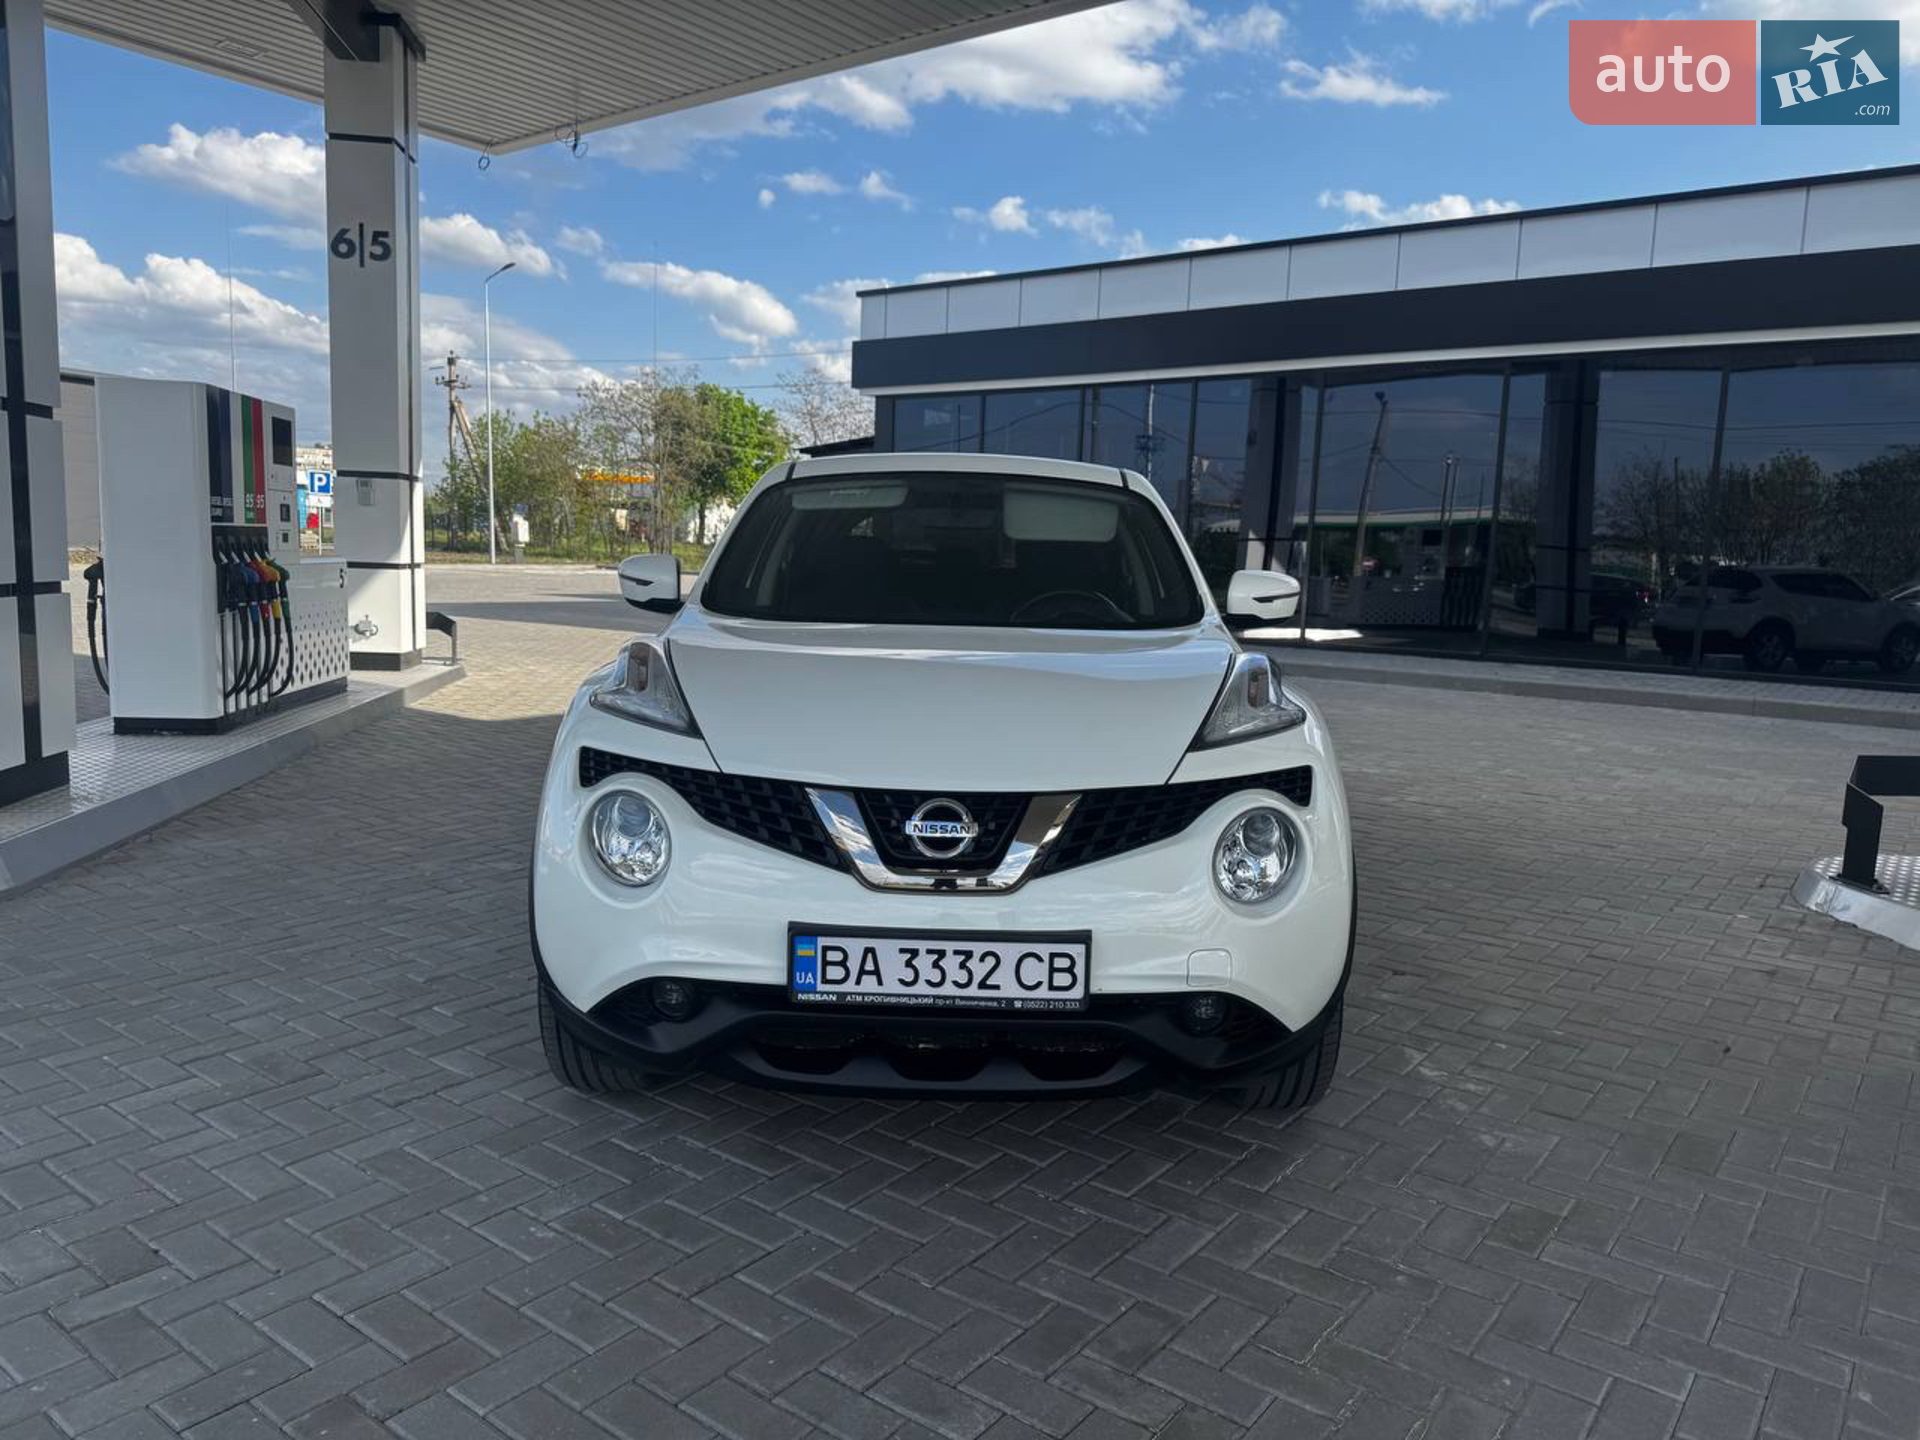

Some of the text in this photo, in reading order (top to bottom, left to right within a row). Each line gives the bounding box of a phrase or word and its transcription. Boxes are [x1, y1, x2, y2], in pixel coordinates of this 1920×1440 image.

[315, 473, 328, 493] P
[256, 494, 265, 509] 95
[913, 823, 970, 835] NISSAN
[820, 944, 1078, 992] BA 3332 CB
[796, 972, 814, 984] UA
[797, 993, 837, 1002] NISSAN
